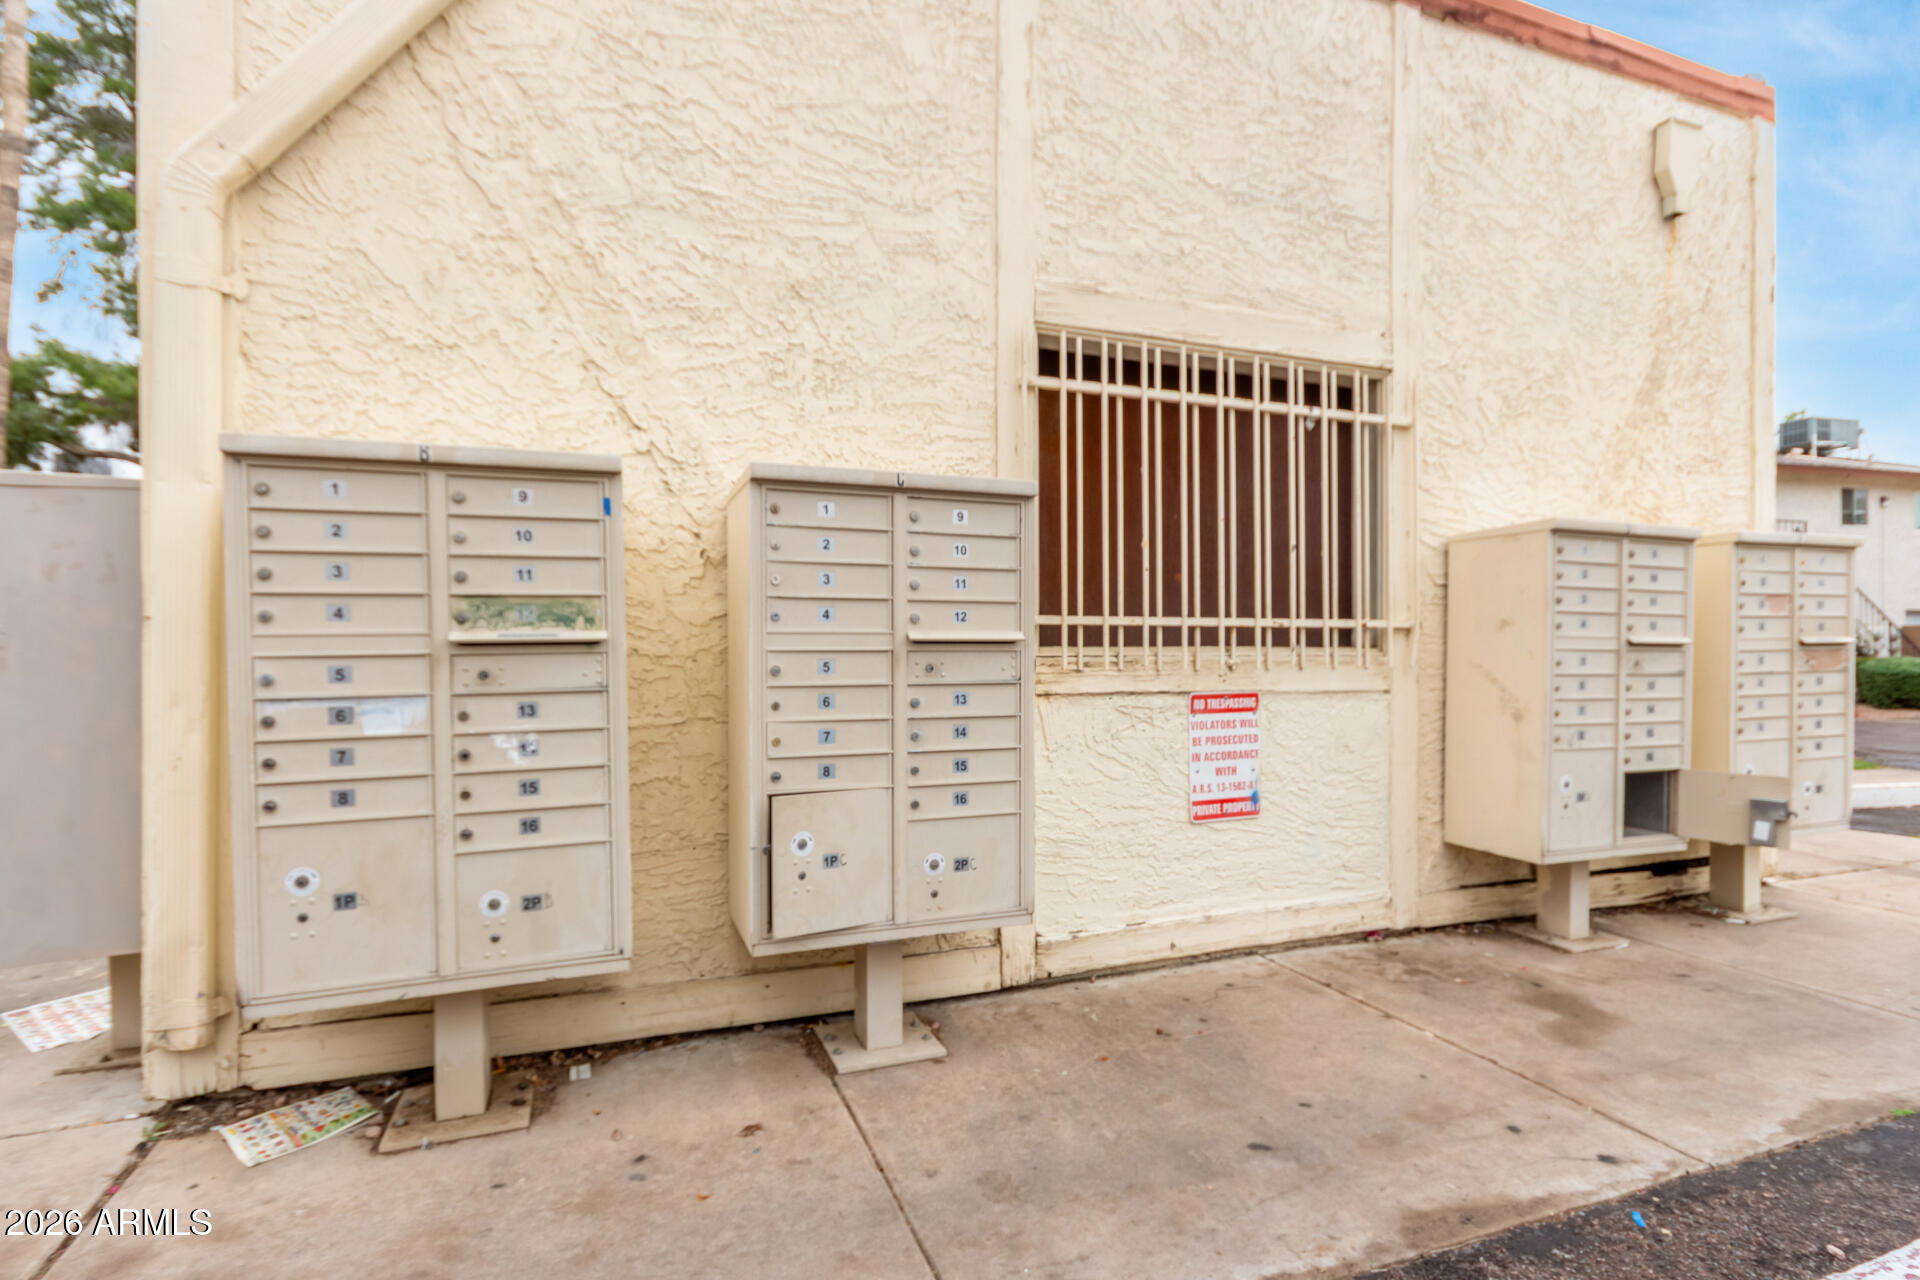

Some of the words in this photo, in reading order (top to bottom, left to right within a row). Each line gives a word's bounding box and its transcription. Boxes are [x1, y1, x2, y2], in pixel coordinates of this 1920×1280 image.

[331, 482, 339, 495] 1
[517, 489, 529, 504] 9
[821, 503, 830, 516] 1
[955, 510, 966, 523] 9
[331, 523, 342, 538] 2
[514, 529, 534, 543] 10
[822, 538, 831, 551] 2
[954, 544, 968, 556] 10
[332, 564, 344, 579] 3
[515, 568, 534, 581] 11
[823, 573, 831, 585] 3
[954, 578, 967, 589] 11
[333, 607, 344, 620] 4
[822, 608, 830, 620] 4
[954, 611, 967, 623] 12
[822, 661, 831, 673] 5
[334, 668, 346, 682] 5
[822, 696, 831, 708] 6
[954, 693, 968, 705] 13
[334, 709, 347, 723] 6
[518, 703, 537, 718] 13
[1190, 719, 1237, 731] VIOLATORS
[1240, 718, 1258, 729] WILL
[823, 730, 831, 743] 7
[954, 727, 967, 738] 14
[1192, 736, 1202, 747] BE
[1205, 734, 1259, 746] PROSECUTED
[336, 750, 347, 764] 7
[1191, 753, 1201, 763] IN
[822, 765, 831, 778] 8
[954, 760, 968, 772] 15
[1215, 766, 1238, 777] WITH
[520, 781, 539, 795] 15
[337, 791, 349, 806] 8
[954, 793, 967, 805] 16
[520, 819, 539, 833] 16
[823, 855, 838, 868] 1P
[954, 859, 969, 871] 2P
[334, 894, 356, 909] 1P
[522, 896, 542, 911] 2P
